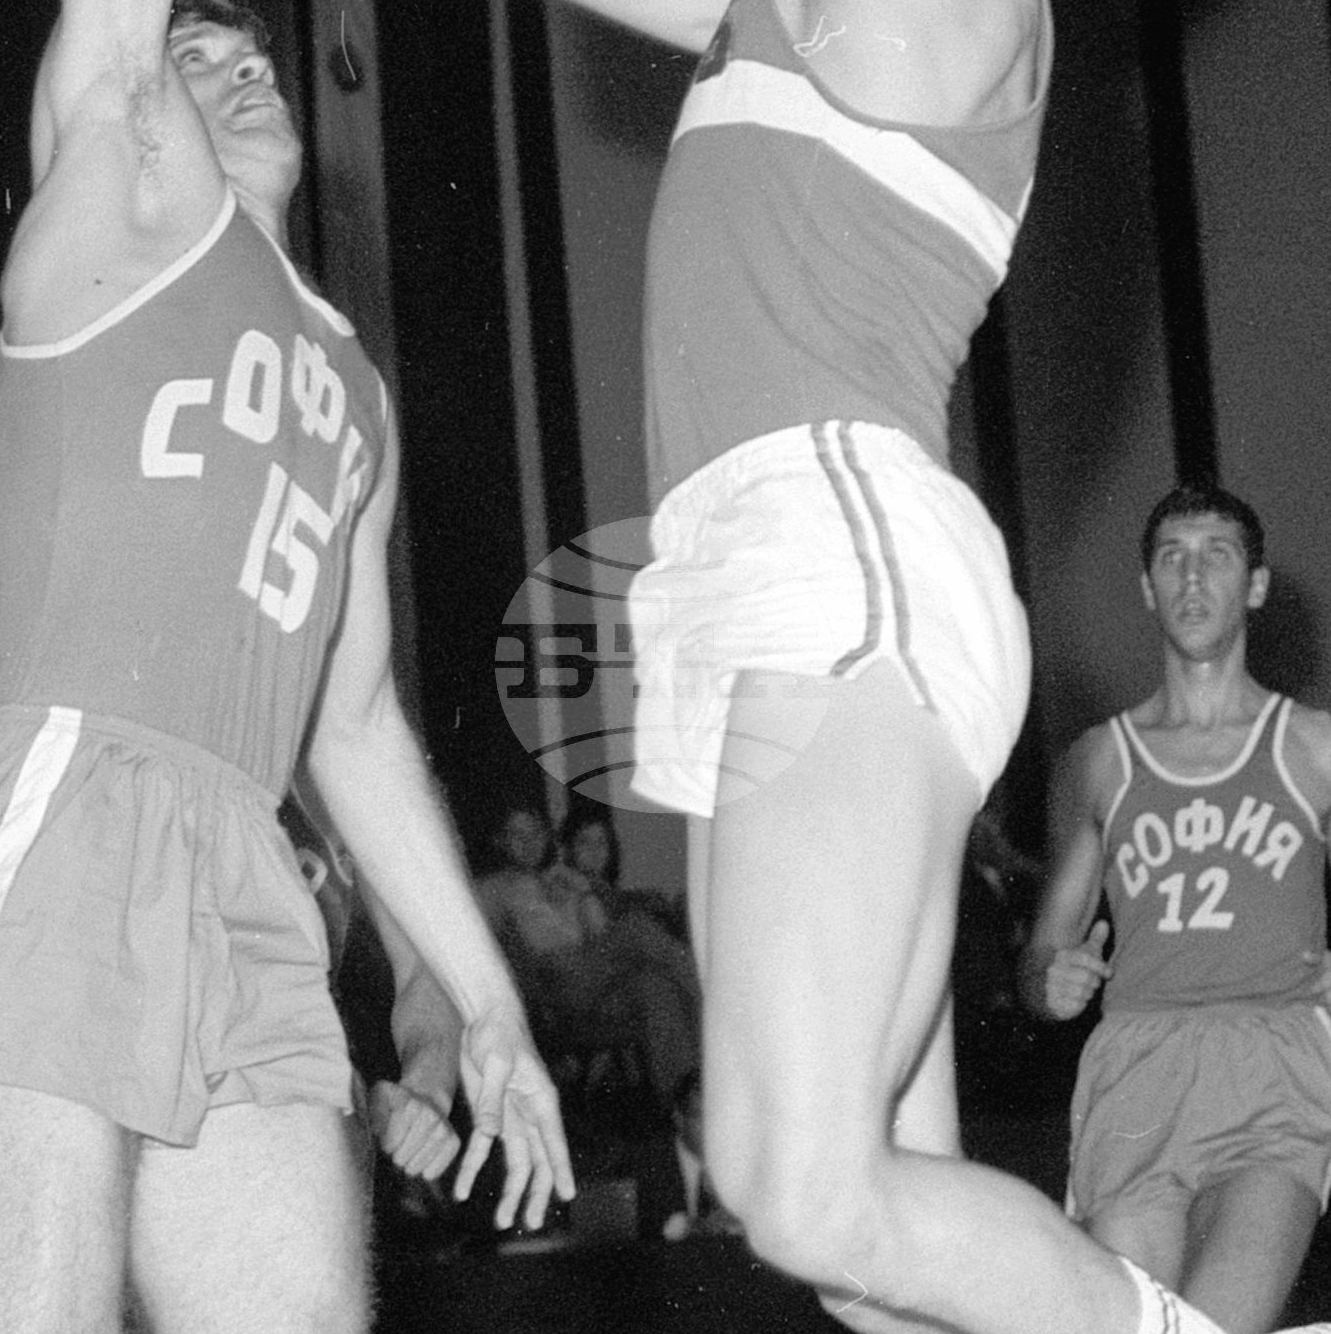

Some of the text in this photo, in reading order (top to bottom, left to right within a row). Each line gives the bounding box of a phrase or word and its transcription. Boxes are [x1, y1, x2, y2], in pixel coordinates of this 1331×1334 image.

[238, 461, 334, 633] 15
[1118, 795, 1304, 899] СОФИЯ
[1157, 866, 1235, 933] 12
